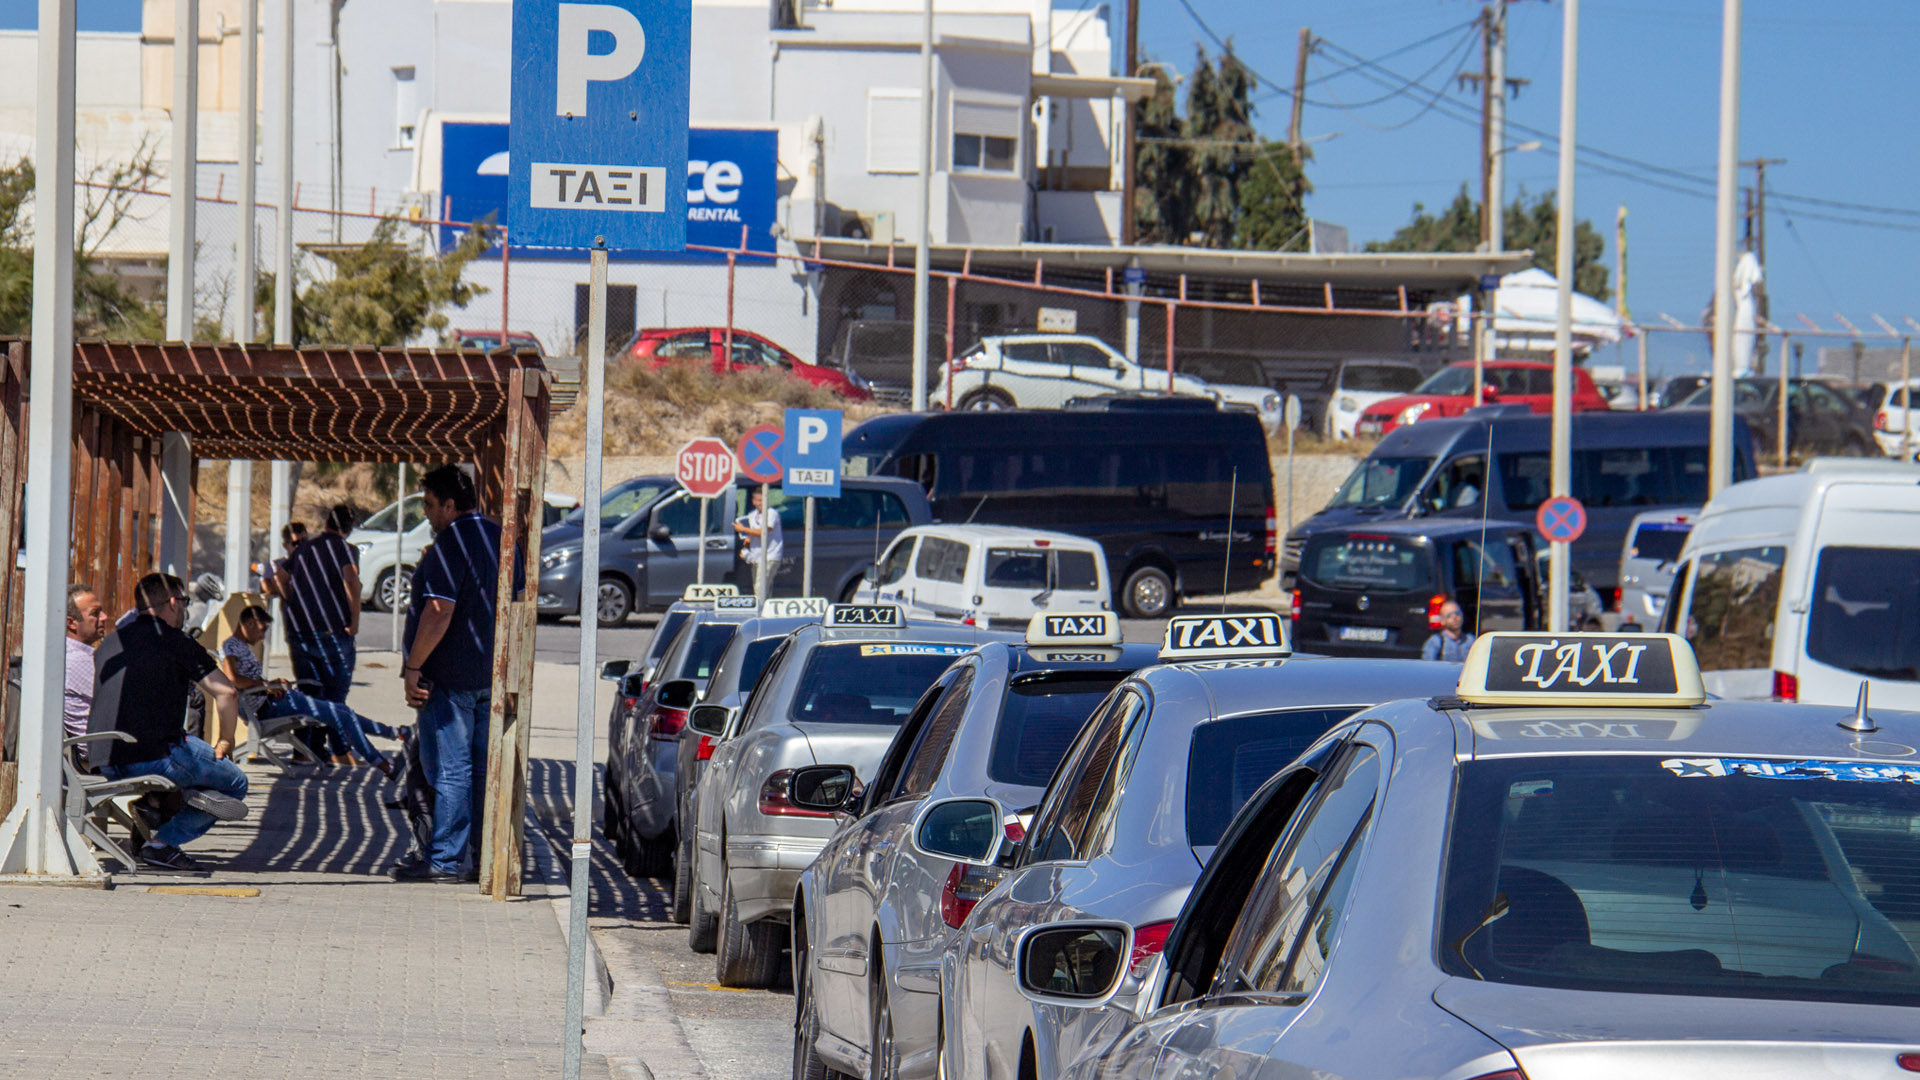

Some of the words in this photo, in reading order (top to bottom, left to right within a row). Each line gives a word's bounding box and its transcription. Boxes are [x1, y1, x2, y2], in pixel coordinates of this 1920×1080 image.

[556, 2, 646, 117] P
[550, 169, 648, 205] ΤΑΞΙ
[688, 207, 742, 223] RENTAL
[797, 416, 828, 455] P
[681, 452, 731, 482] STOP
[692, 588, 733, 597] TAXI
[769, 600, 825, 615] TAXI
[835, 607, 894, 623] TAXI
[1049, 616, 1104, 635] TAXI
[1175, 617, 1278, 648] TAXI
[894, 646, 937, 654] Blue
[1514, 639, 1648, 689] TAXI
